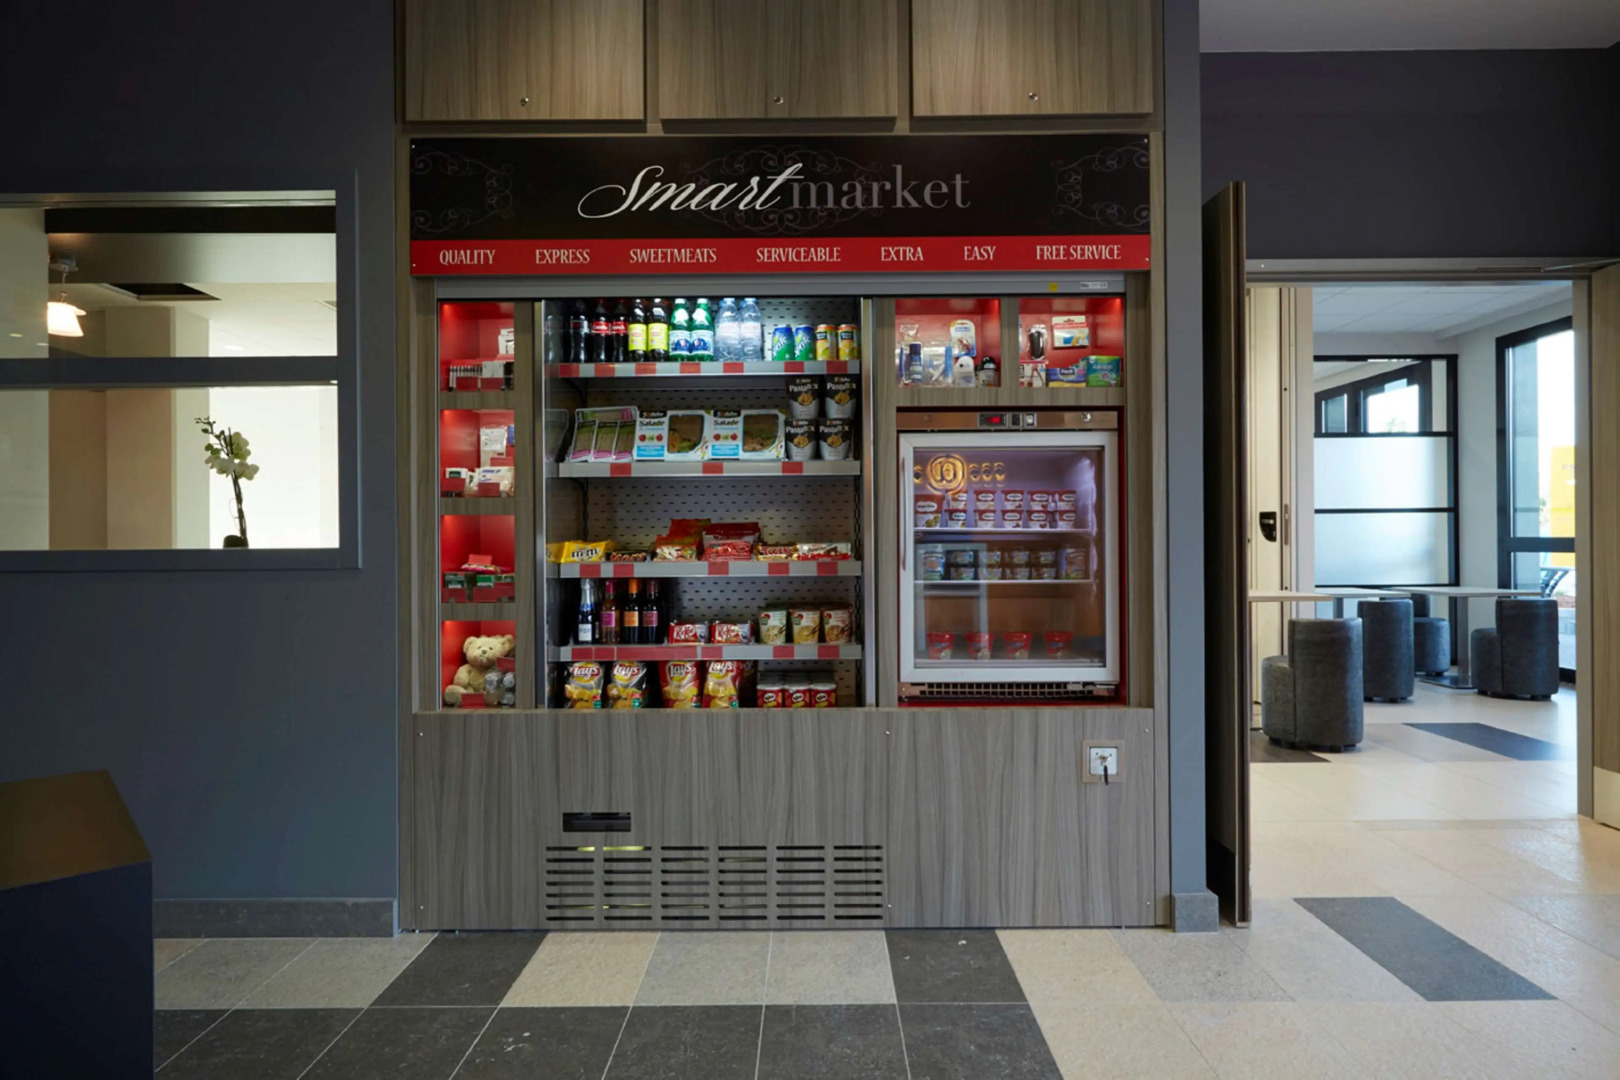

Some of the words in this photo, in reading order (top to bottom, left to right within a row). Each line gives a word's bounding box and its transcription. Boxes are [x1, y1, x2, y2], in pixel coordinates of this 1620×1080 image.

[578, 163, 804, 218] Smart
[790, 165, 971, 208] market
[439, 249, 496, 265] QUALITY
[534, 248, 591, 265] EXPRESS
[629, 247, 717, 264] SWEETMEATS
[756, 246, 842, 263] SERVICEABLE
[880, 246, 924, 262] EXTRA
[963, 245, 997, 262] EASY
[1036, 245, 1067, 261] FREE
[1069, 244, 1122, 261] SERVICE
